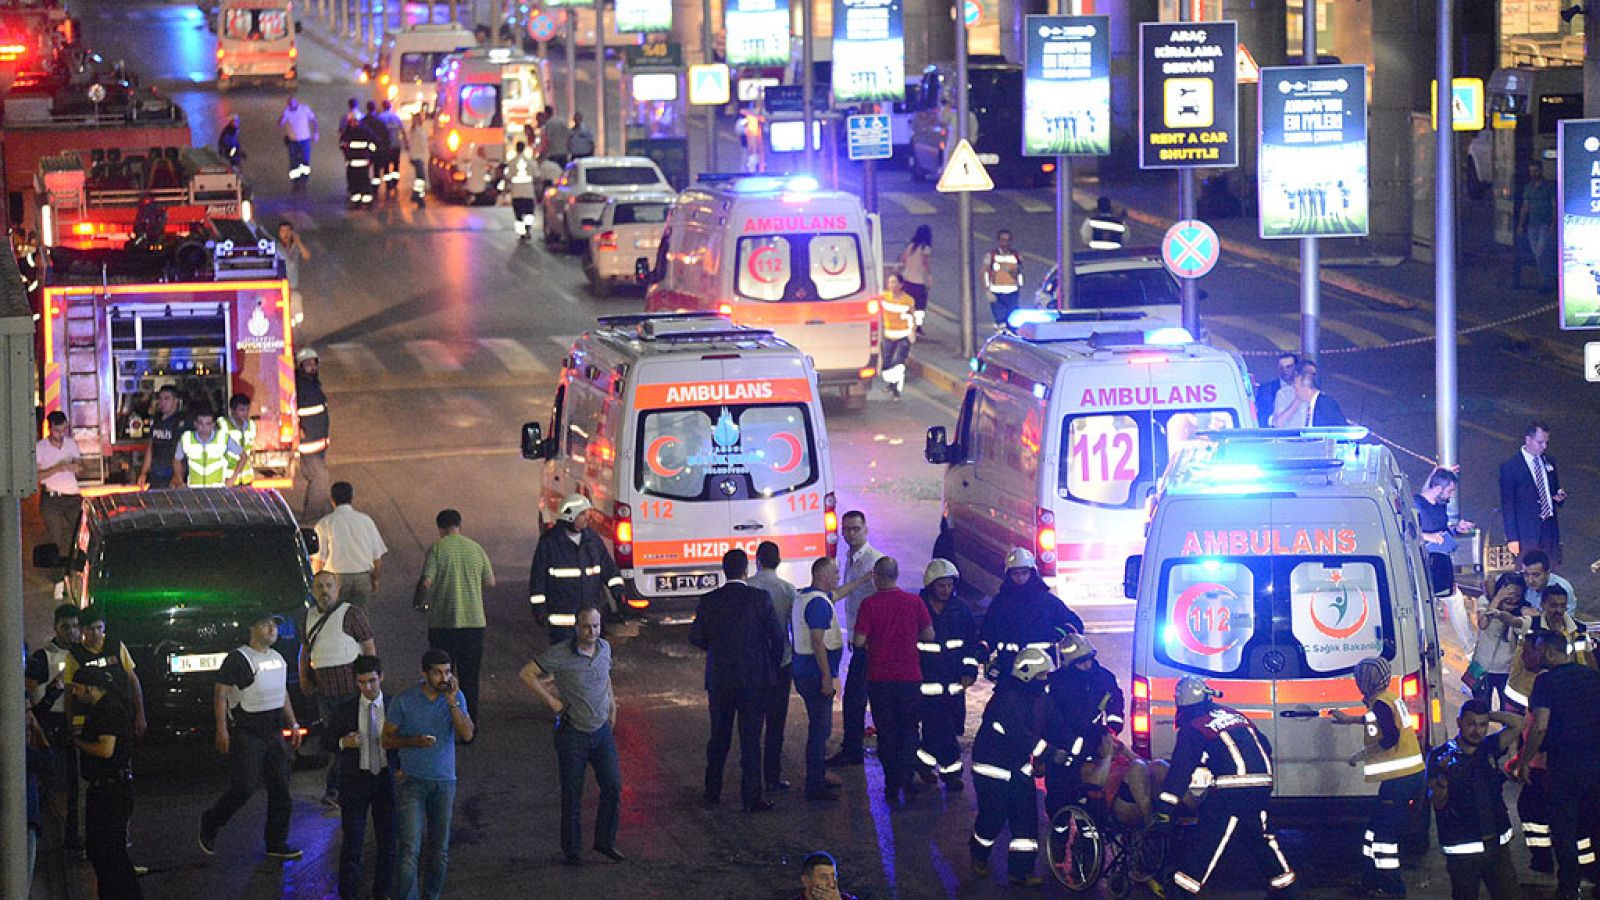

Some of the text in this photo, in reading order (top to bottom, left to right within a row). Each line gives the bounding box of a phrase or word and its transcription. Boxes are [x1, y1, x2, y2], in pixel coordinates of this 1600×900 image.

[1170, 30, 1207, 44] ARAÇ
[1150, 131, 1228, 144] RENT A CAR
[1159, 147, 1219, 160] SHUTTLE
[744, 215, 848, 233] AMBULANS
[757, 257, 782, 272] 112
[666, 382, 773, 403] AMBULANS
[1080, 384, 1217, 407] AMBULANS
[1072, 432, 1136, 481] 112
[640, 500, 673, 520] 112
[787, 492, 820, 512] 112
[1181, 528, 1356, 556] AMBULANS
[660, 577, 672, 590] 34
[1190, 606, 1230, 632] 112
